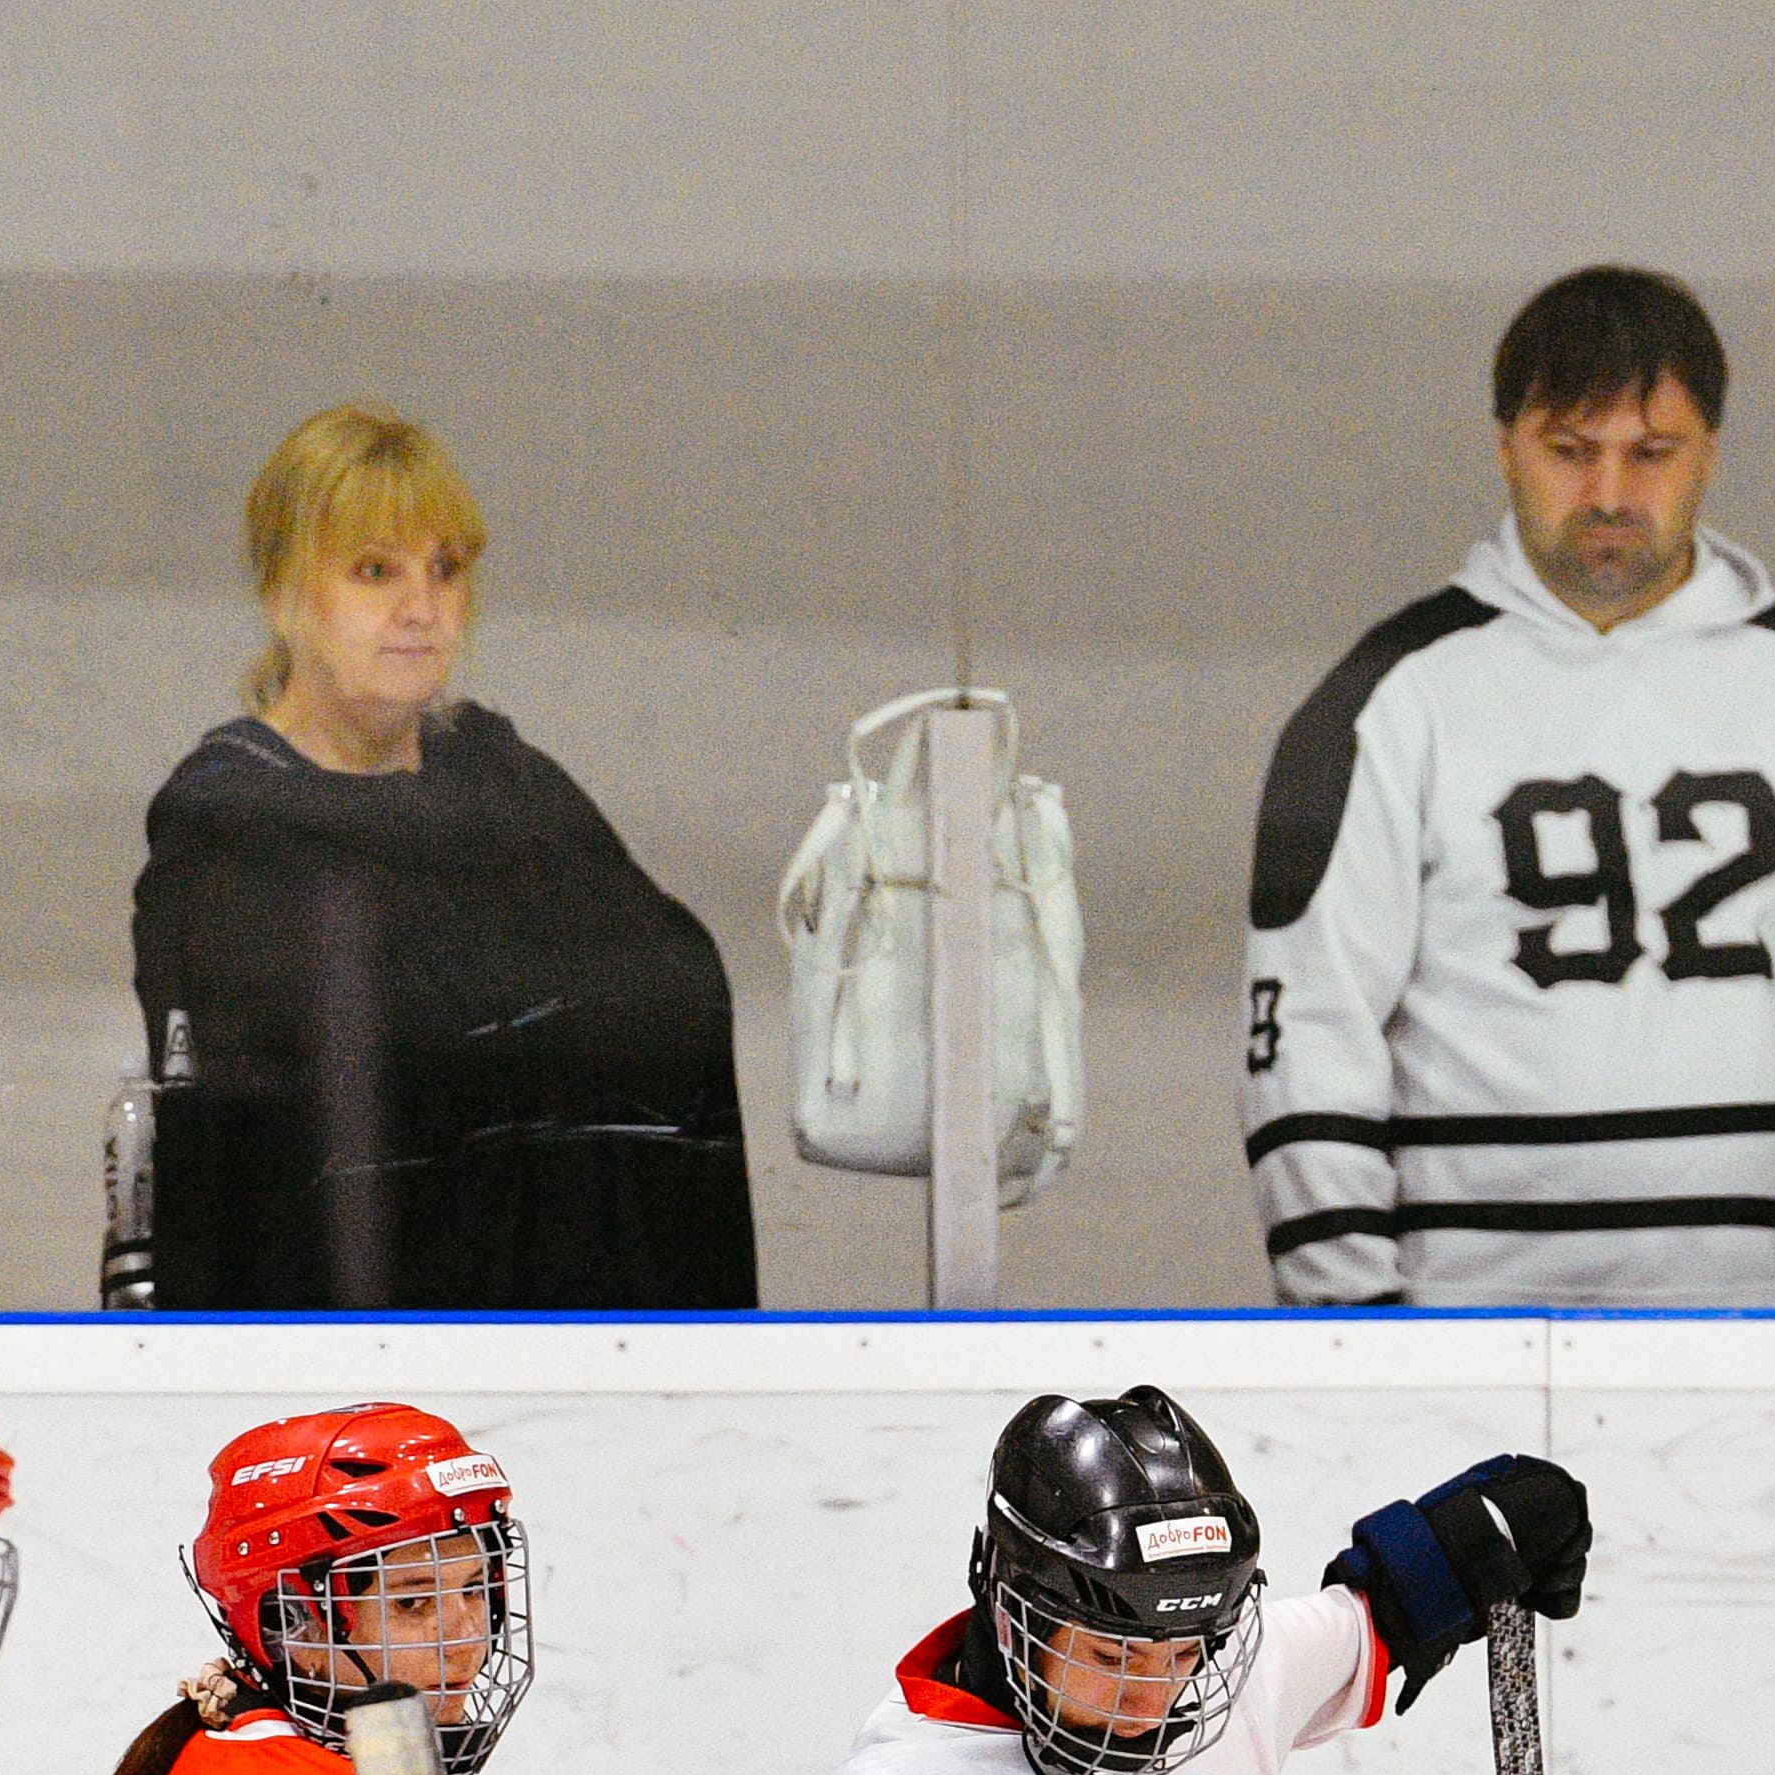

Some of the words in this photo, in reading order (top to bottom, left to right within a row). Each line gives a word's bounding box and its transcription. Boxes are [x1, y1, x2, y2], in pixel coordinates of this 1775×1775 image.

[231, 1456, 309, 1486] EFSI
[1148, 1522, 1228, 1551] ДоброFON
[1156, 1592, 1223, 1612] CCM
